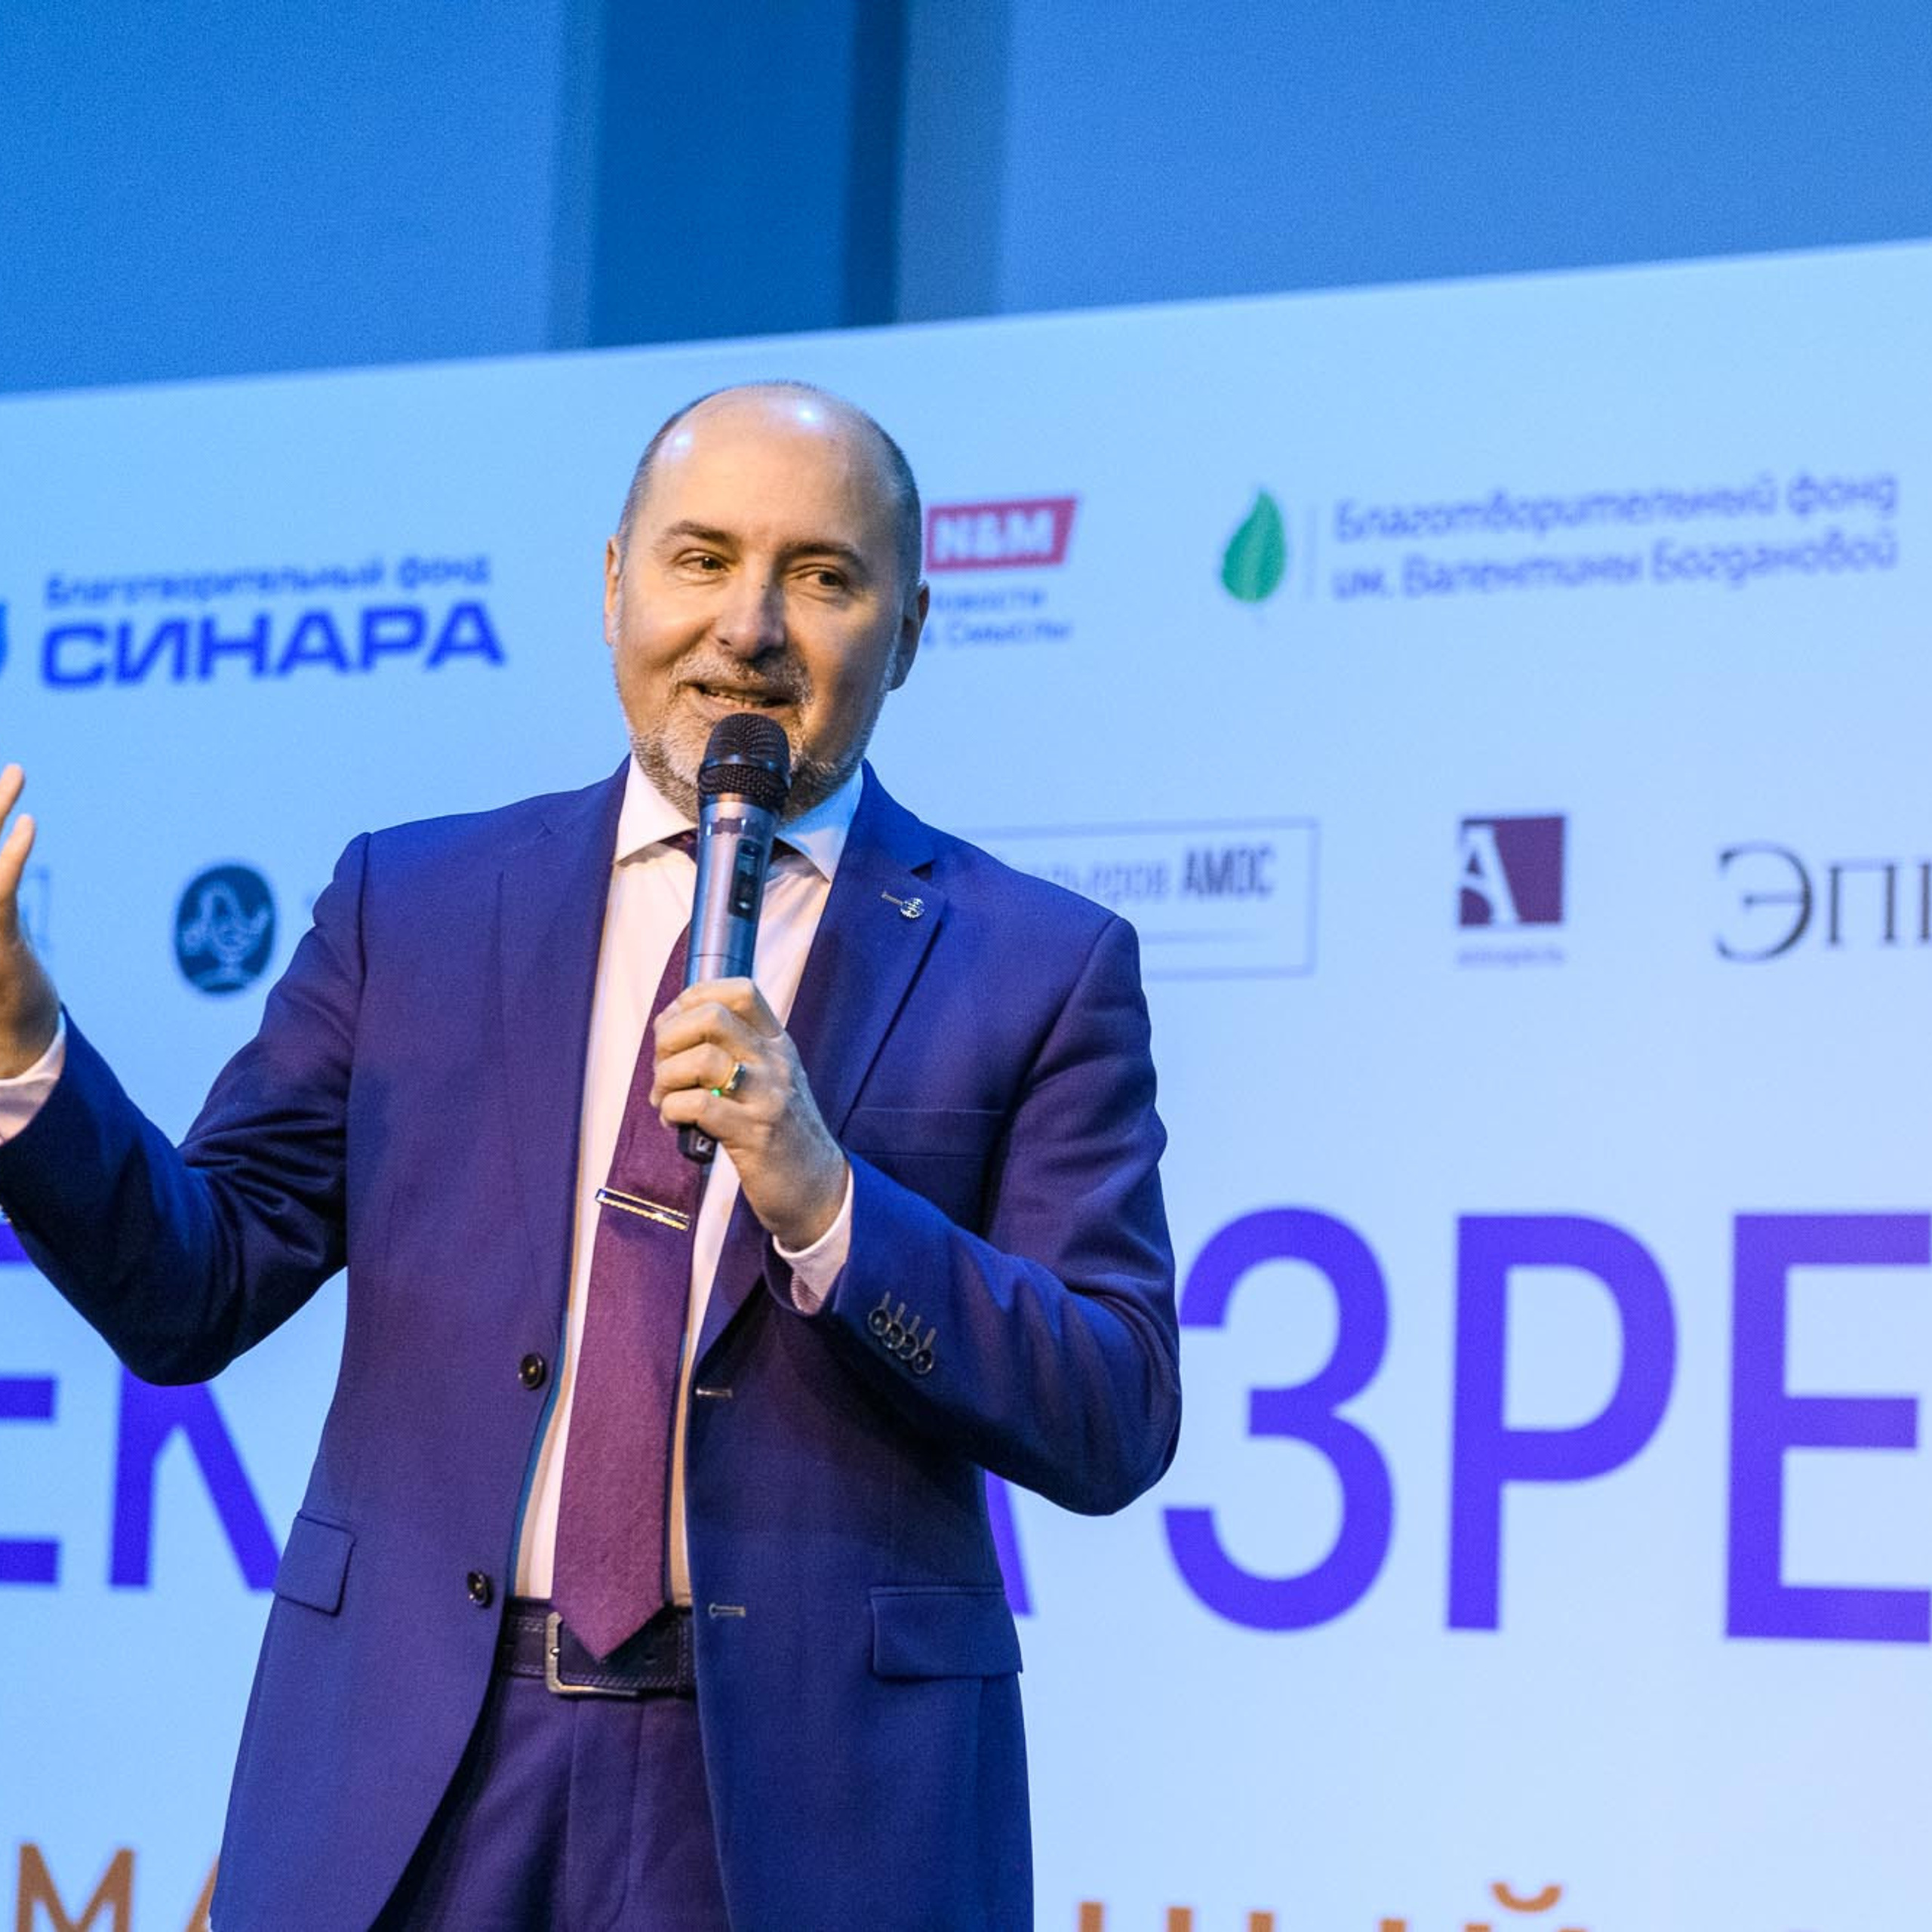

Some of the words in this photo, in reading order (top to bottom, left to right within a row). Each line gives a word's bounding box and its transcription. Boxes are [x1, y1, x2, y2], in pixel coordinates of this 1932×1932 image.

[1334, 475, 1776, 543] Благотворительный
[1788, 474, 1899, 521] фонд
[47, 555, 383, 605] Благотворительный
[399, 555, 490, 589] фонд
[1401, 554, 1643, 598] Валентины
[1652, 528, 1899, 589] Богдановой
[42, 601, 506, 688] СИНАРА
